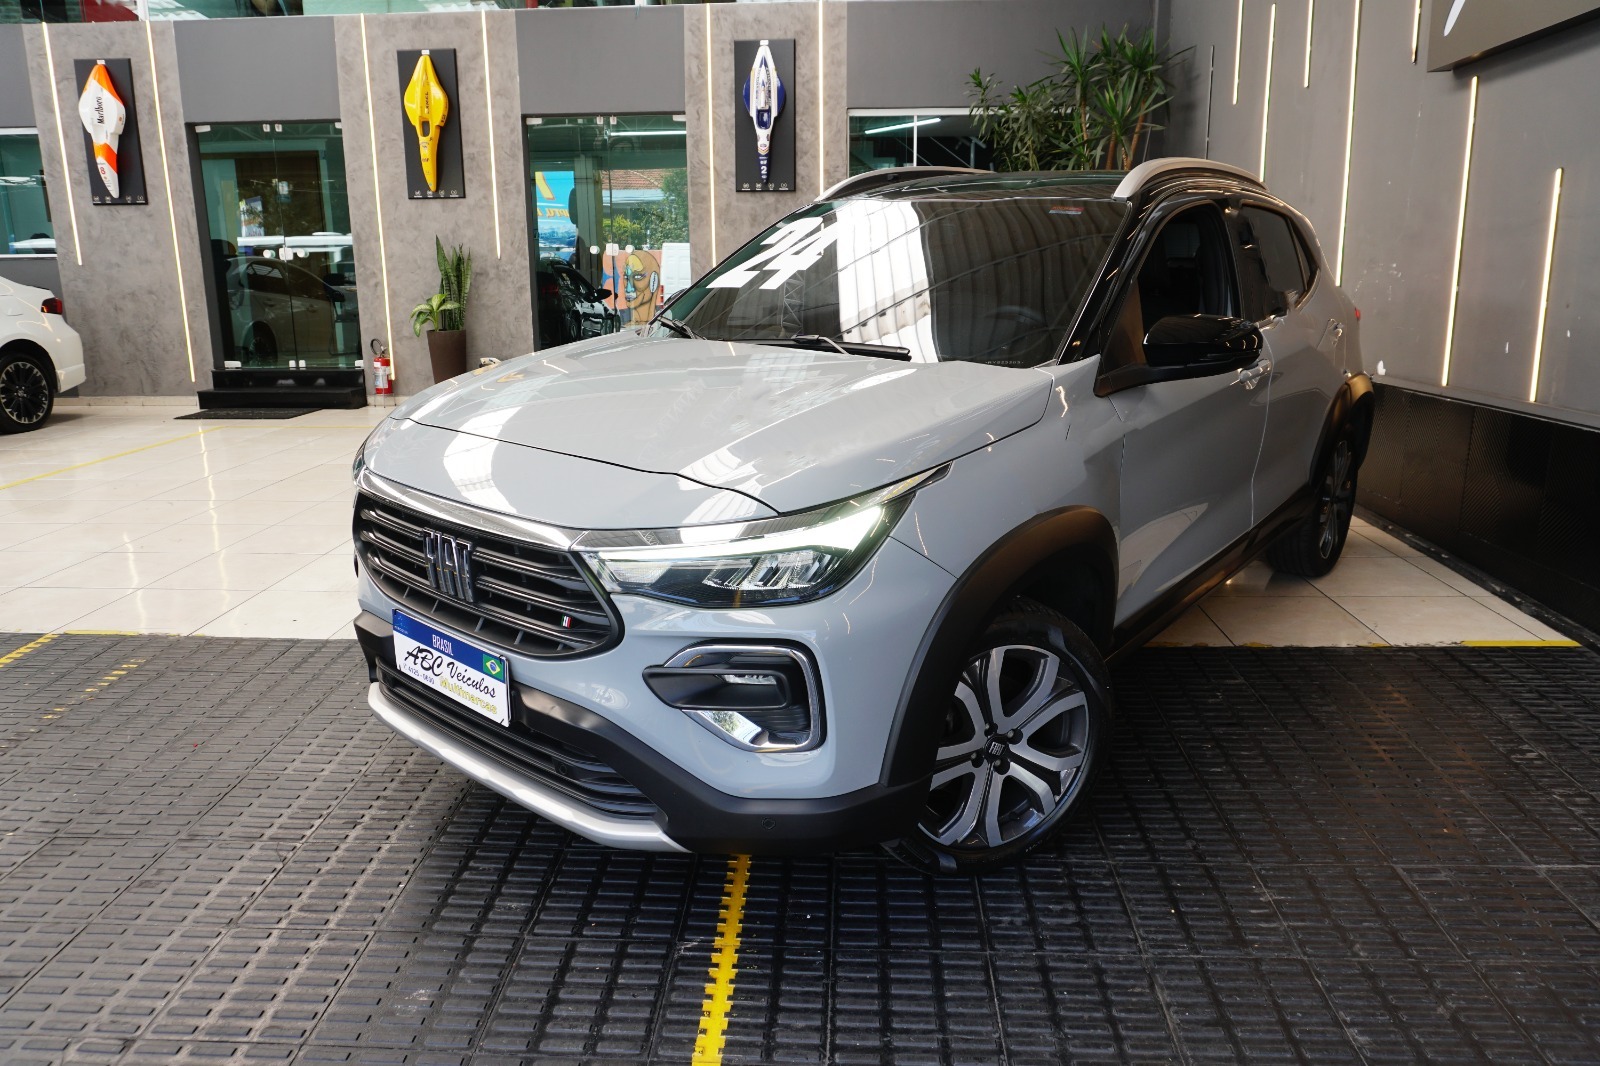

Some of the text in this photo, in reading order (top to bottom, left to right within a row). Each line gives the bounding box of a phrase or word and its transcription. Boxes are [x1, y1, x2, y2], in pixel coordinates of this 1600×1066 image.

[94, 96, 104, 125] Marlboro
[100, 166, 106, 175] 8
[760, 165, 768, 174] 2
[707, 217, 838, 290] 24
[422, 527, 474, 603] FIAT
[431, 634, 454, 656] BRASIL
[404, 645, 497, 698] ABC Veículos
[439, 676, 498, 715] Multimarcas
[988, 741, 1005, 756] FIAT
